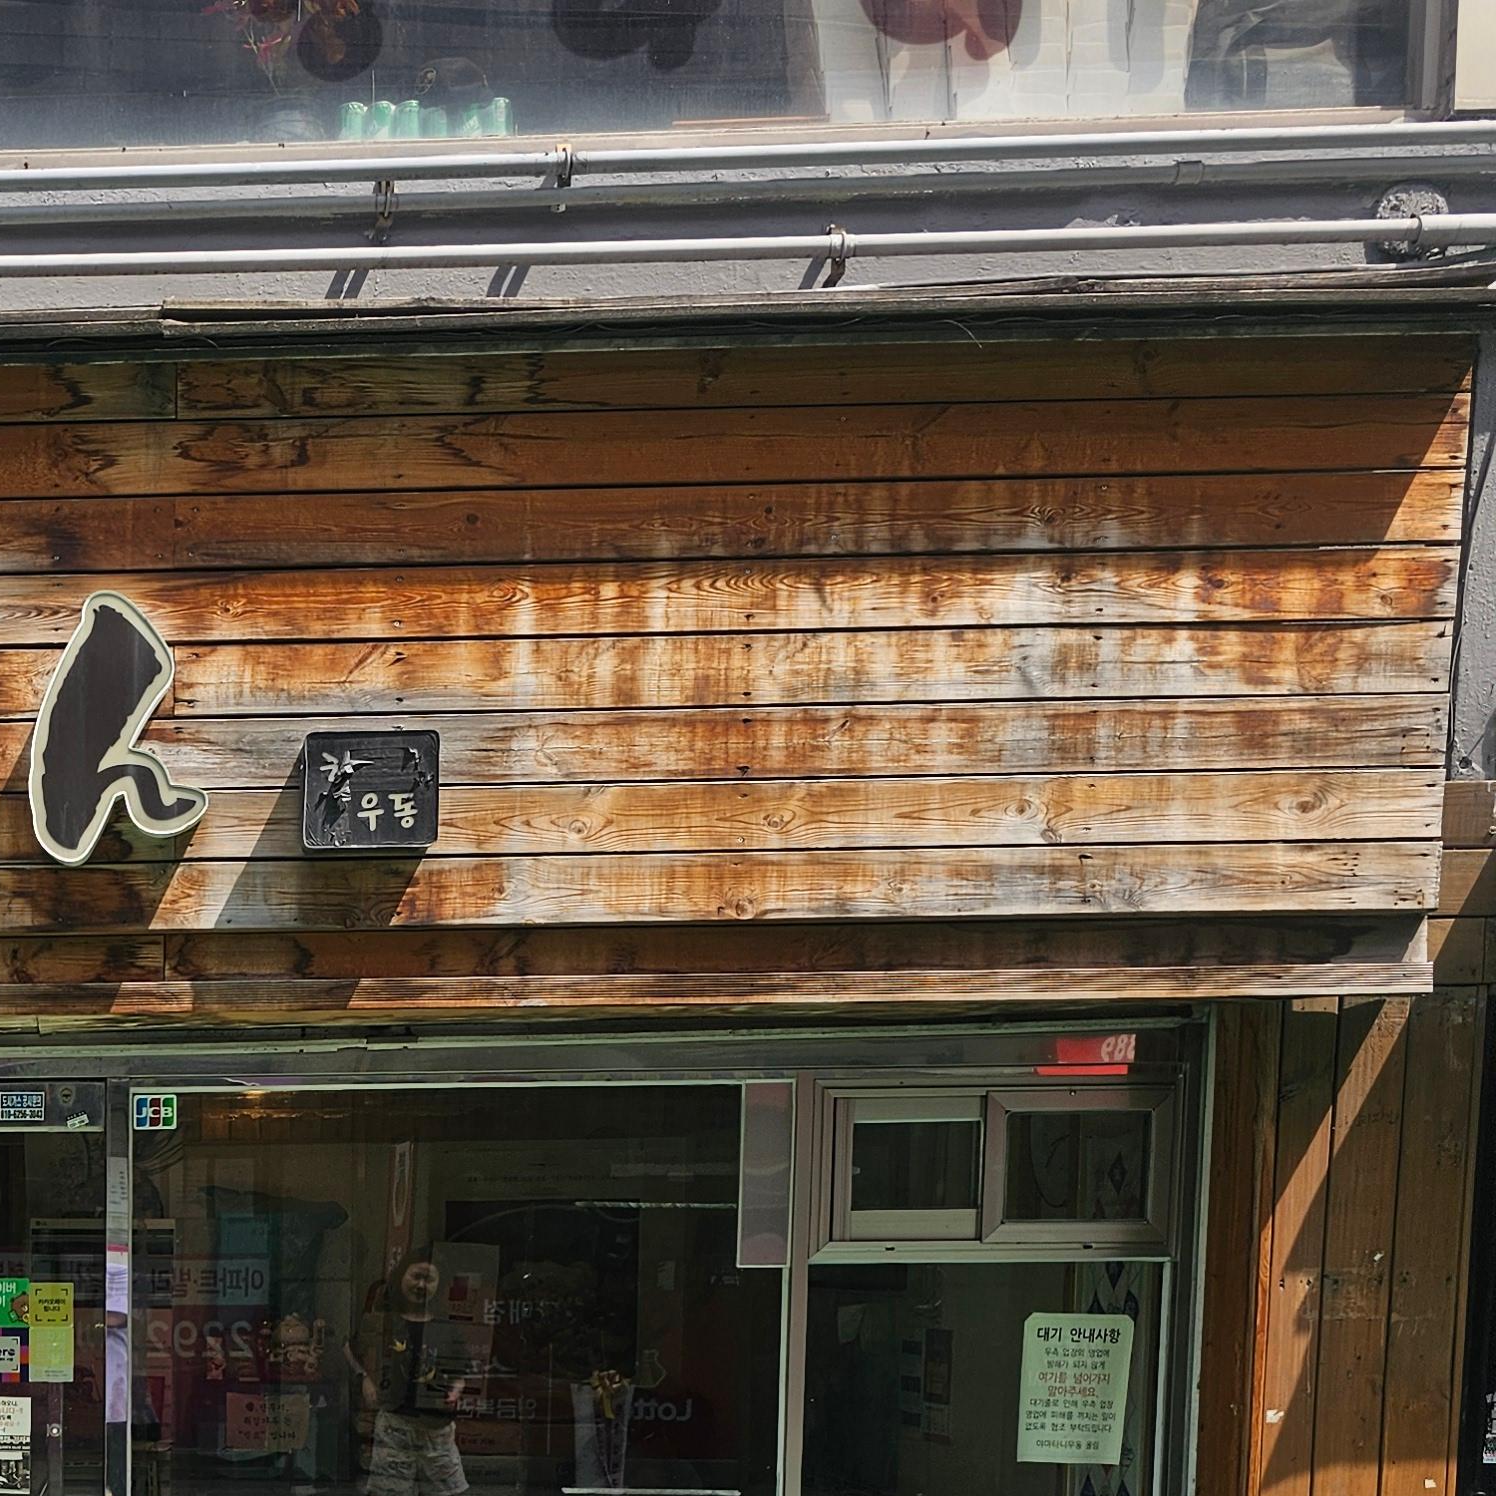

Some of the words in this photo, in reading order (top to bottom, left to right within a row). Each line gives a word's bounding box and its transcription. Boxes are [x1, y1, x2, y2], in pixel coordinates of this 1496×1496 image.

[357, 792, 418, 832] 우동
[135, 1107, 174, 1118] JCB
[1037, 1327, 1062, 1342] 대기
[1070, 1327, 1120, 1344] 안내사항
[1038, 1372, 1067, 1384] 여기를
[1073, 1373, 1110, 1384] 넘어가지
